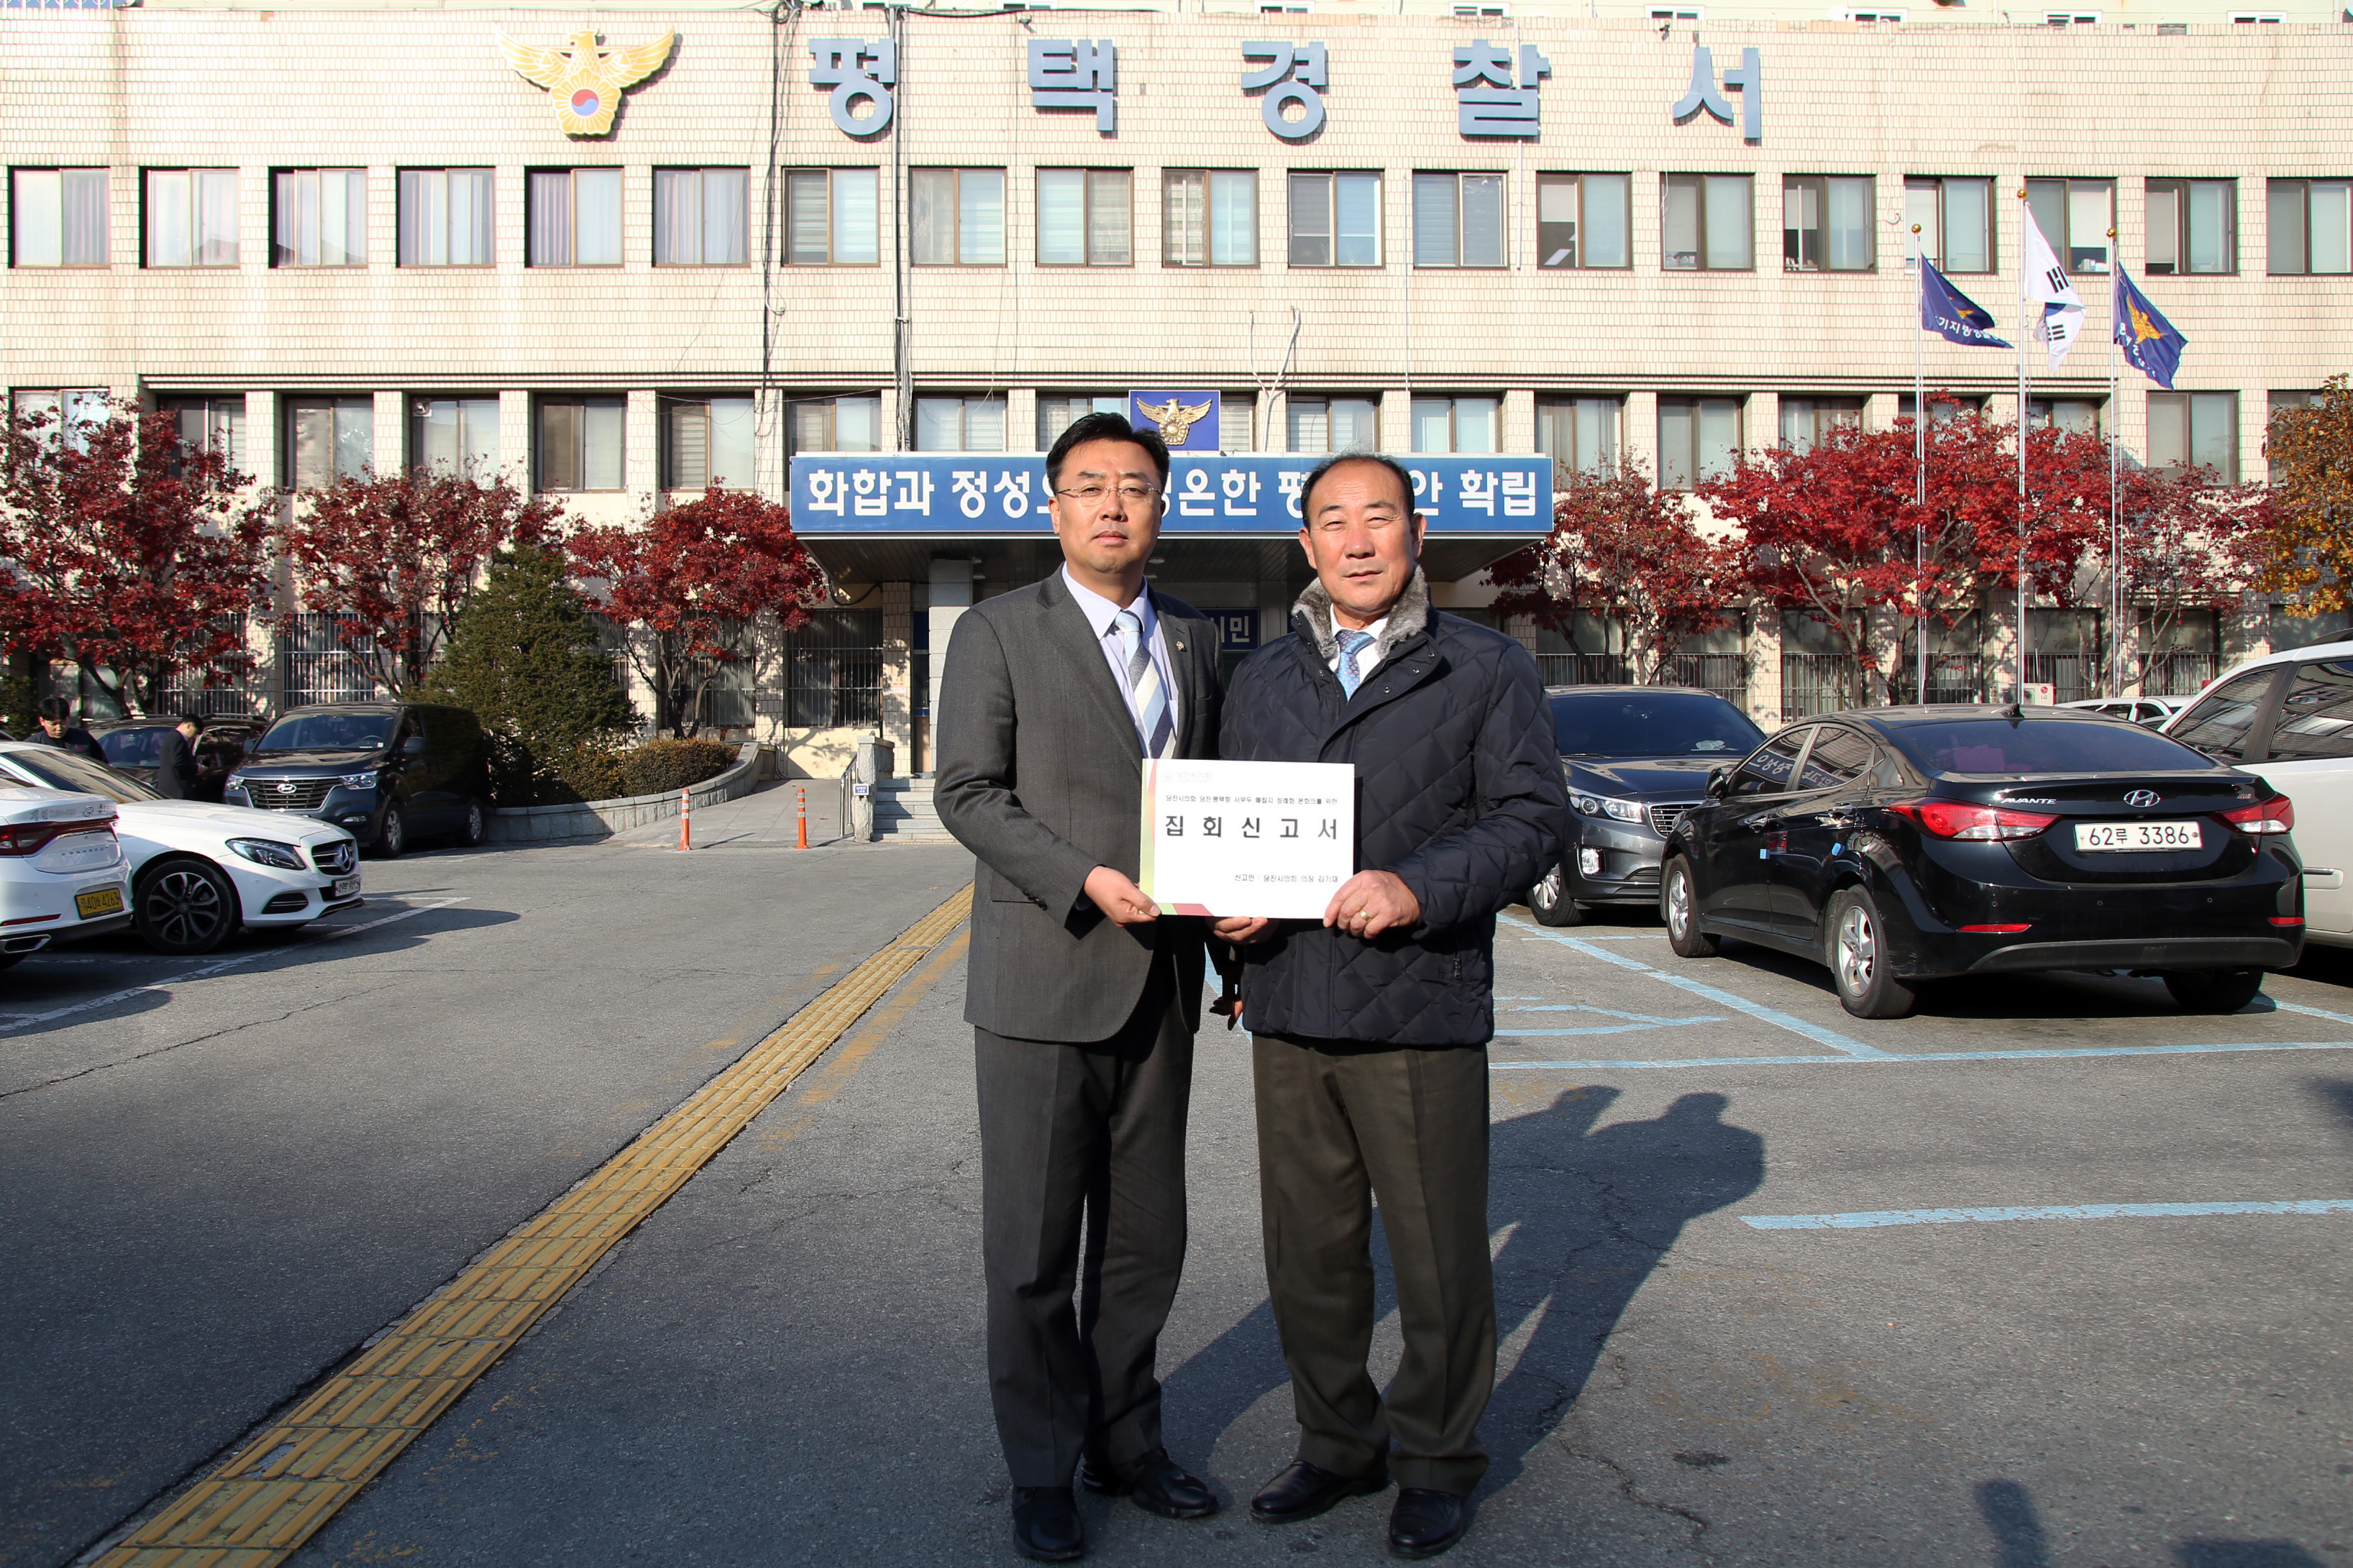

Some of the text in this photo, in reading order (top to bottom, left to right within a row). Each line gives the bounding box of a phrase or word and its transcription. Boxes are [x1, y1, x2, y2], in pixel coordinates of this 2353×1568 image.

[808, 469, 935, 517] 화합과
[1459, 469, 1536, 517] 확립
[2088, 826, 2190, 845] 62루 3386
[1235, 874, 1255, 882] 신고인
[1263, 874, 1297, 883] 당진시의회
[102, 891, 119, 907] 4263
